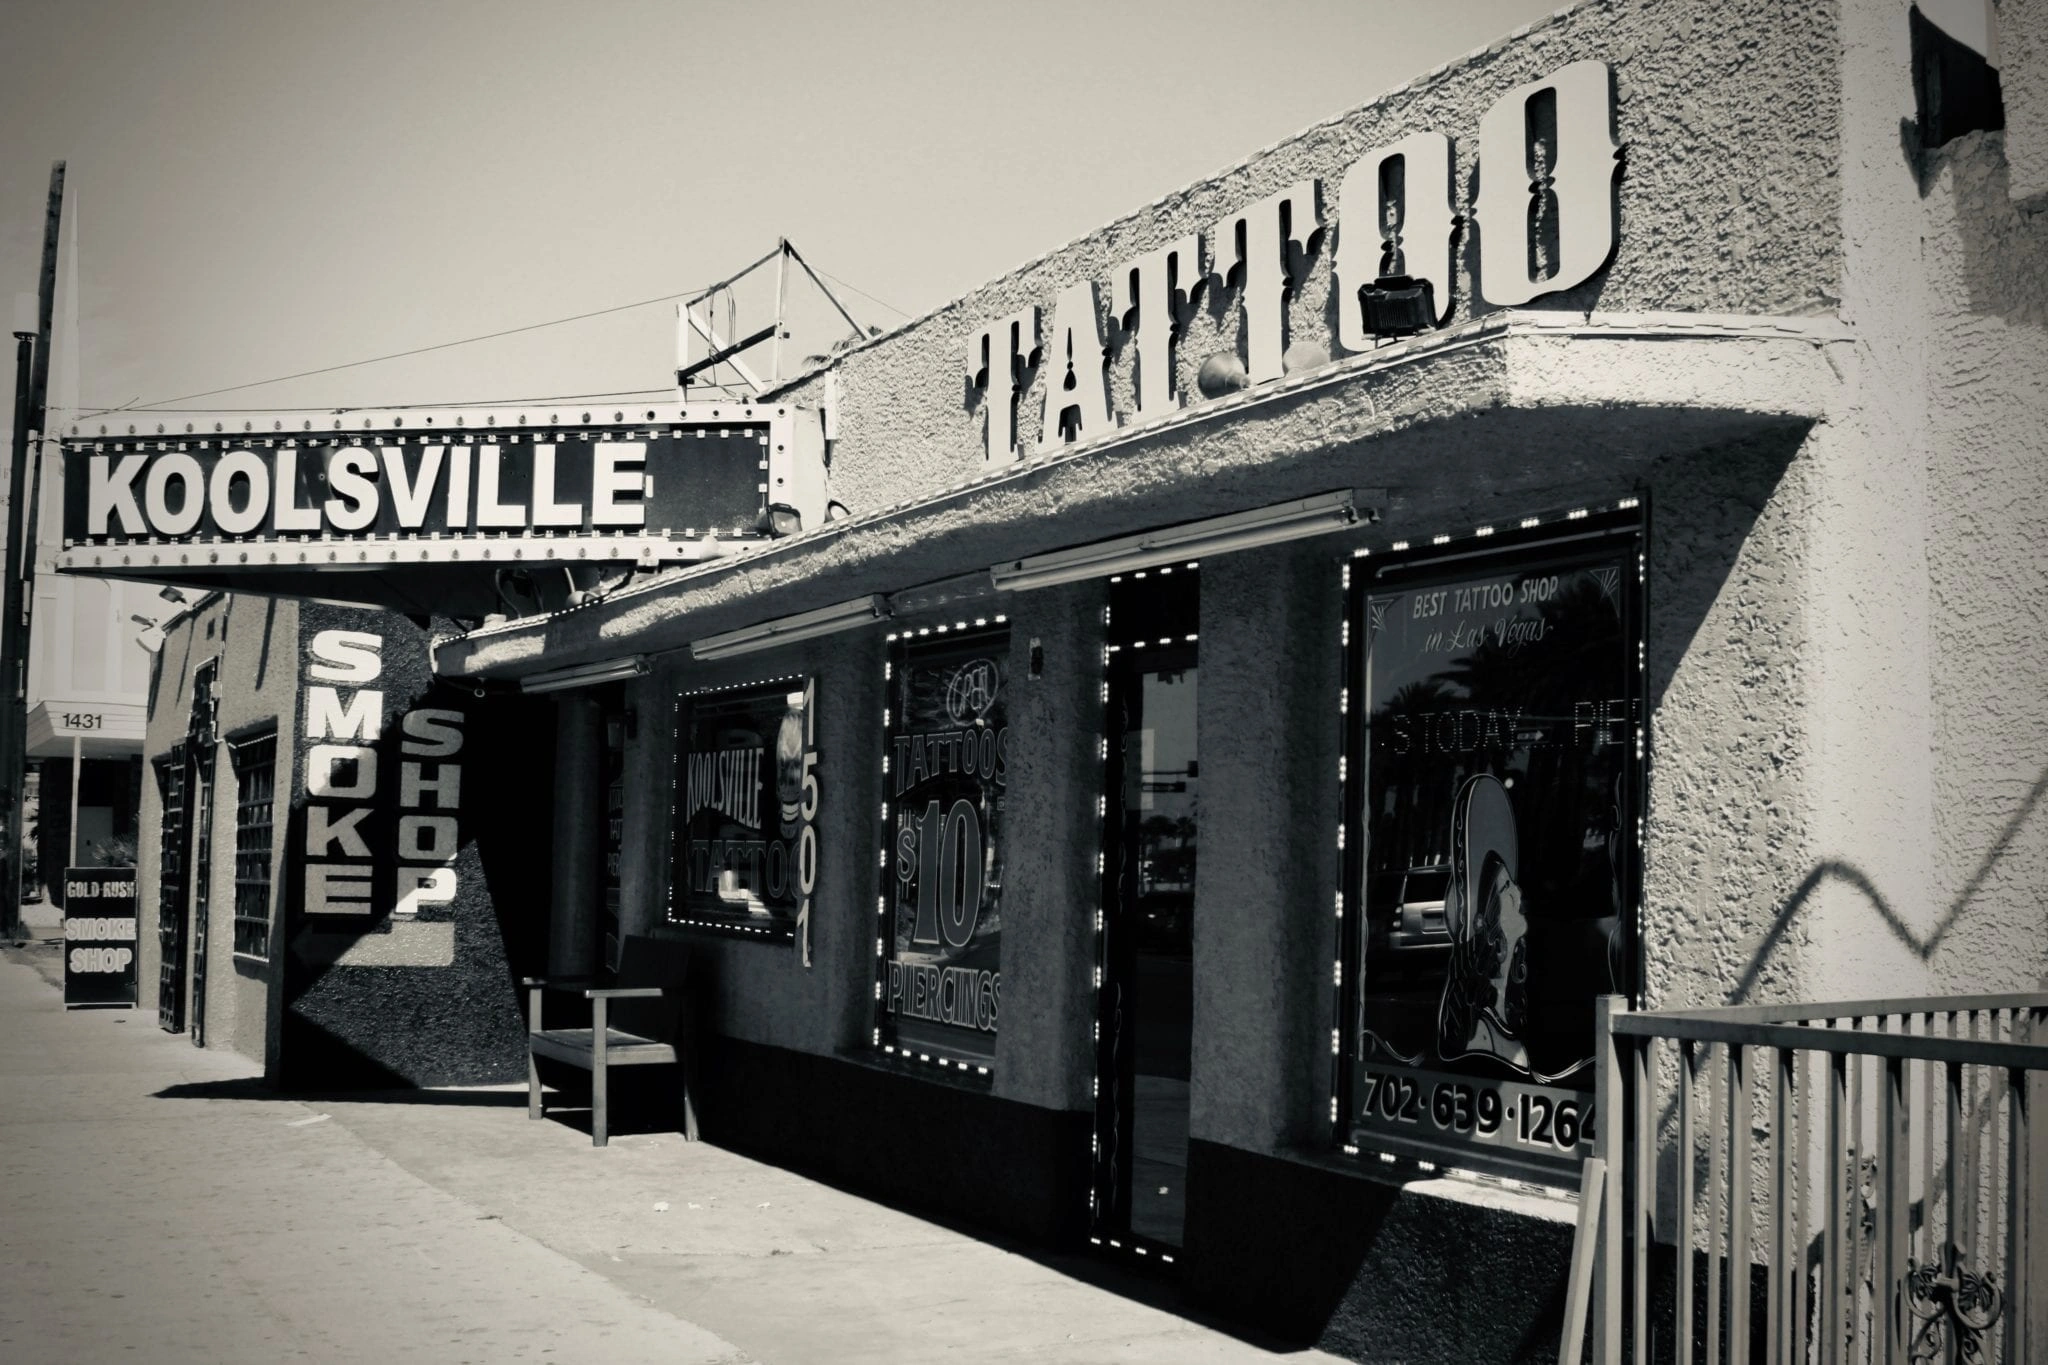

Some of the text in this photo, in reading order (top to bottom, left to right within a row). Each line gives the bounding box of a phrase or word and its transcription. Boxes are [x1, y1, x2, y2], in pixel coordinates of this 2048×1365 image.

[966, 59, 1618, 470] TATTOO
[88, 442, 648, 536] KOOLSVILLE
[1412, 576, 1559, 619] BEST TATTOO SHOP
[1422, 615, 1554, 659] in Las Vegas
[62, 712, 103, 729] 1431
[304, 629, 383, 915] SMOKE
[685, 747, 766, 831] KOOLSVILLE
[893, 724, 1008, 798] TATTOOS
[395, 708, 465, 915] SHOP
[796, 676, 820, 968] 1501
[896, 798, 982, 948] $10
[65, 917, 137, 941] SMOKE
[69, 947, 133, 974] SHOP
[886, 959, 1003, 1032] PIERCINGS
